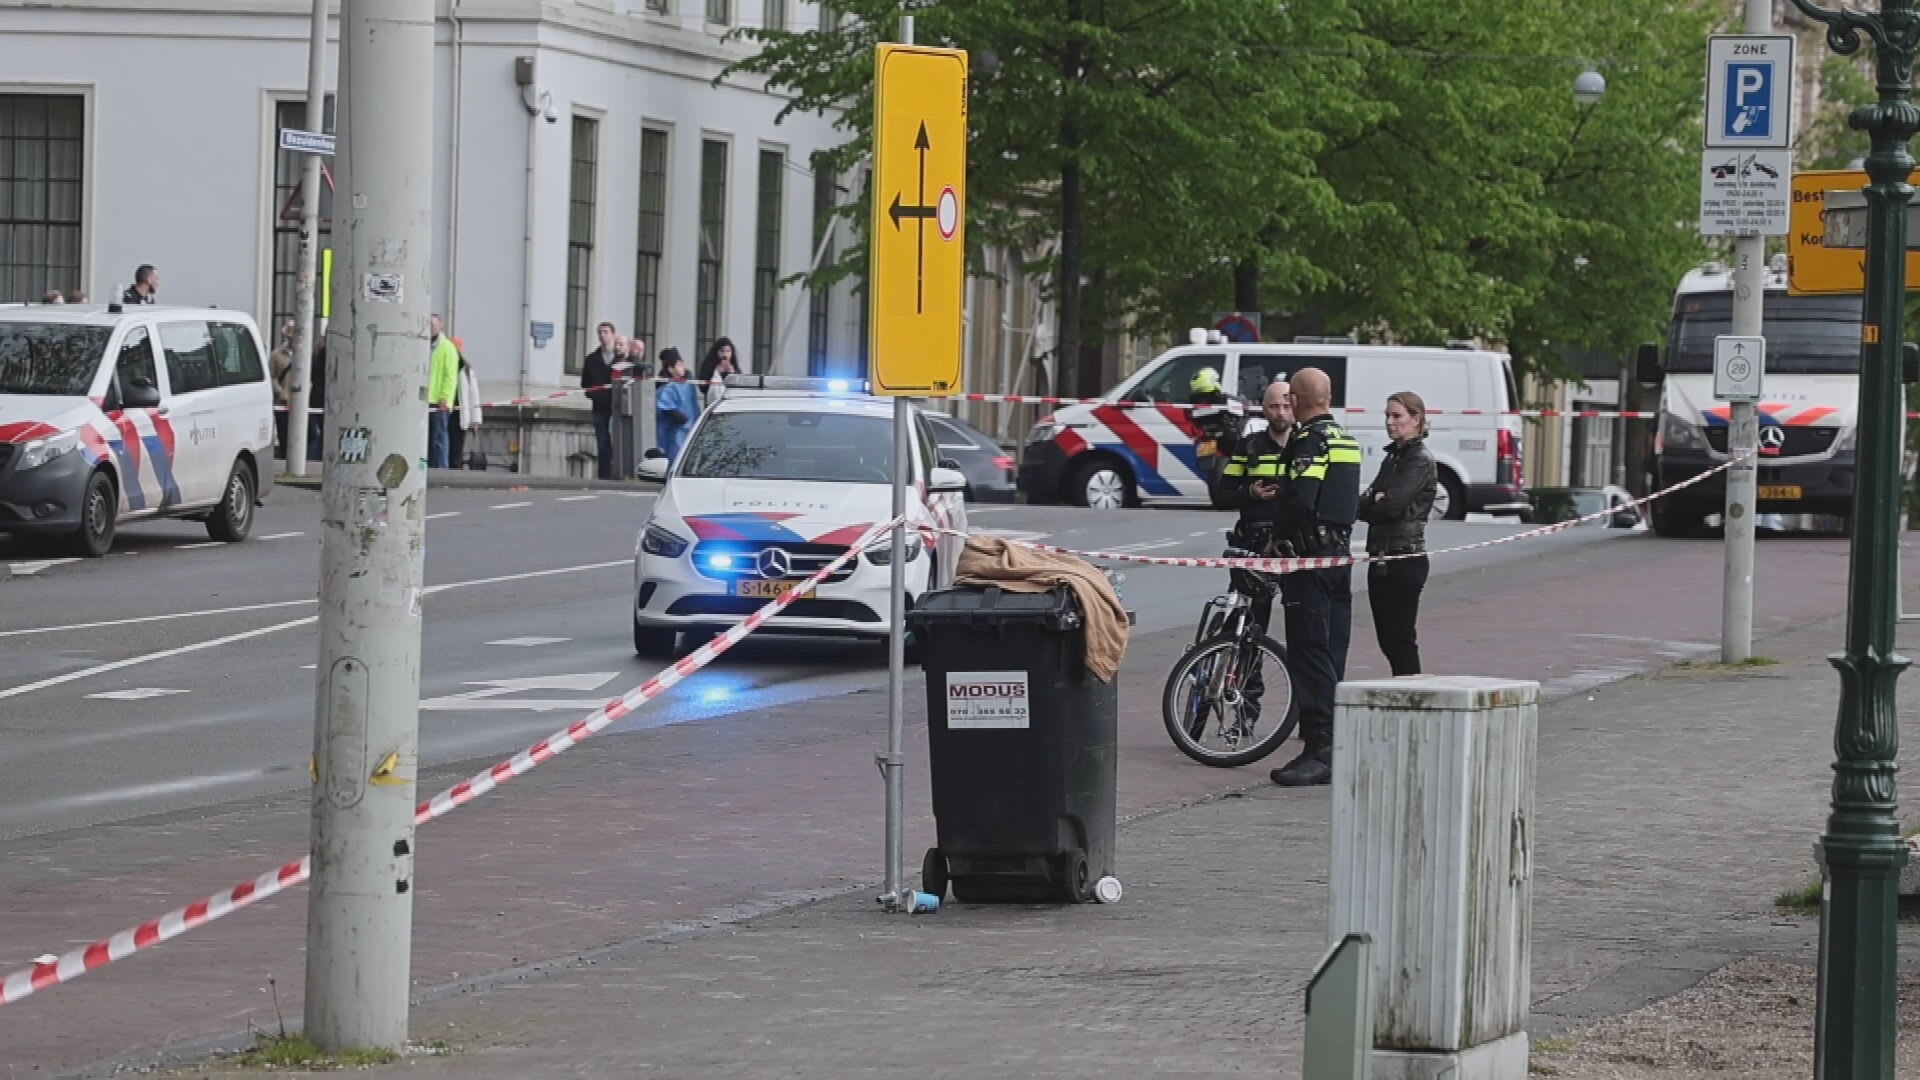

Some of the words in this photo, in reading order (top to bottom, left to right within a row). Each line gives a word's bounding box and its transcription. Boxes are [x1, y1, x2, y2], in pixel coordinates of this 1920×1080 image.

[1733, 44, 1768, 54] ZONE
[1736, 68, 1763, 106] P
[1731, 363, 1747, 374] 28
[949, 685, 1025, 697] MODUS
